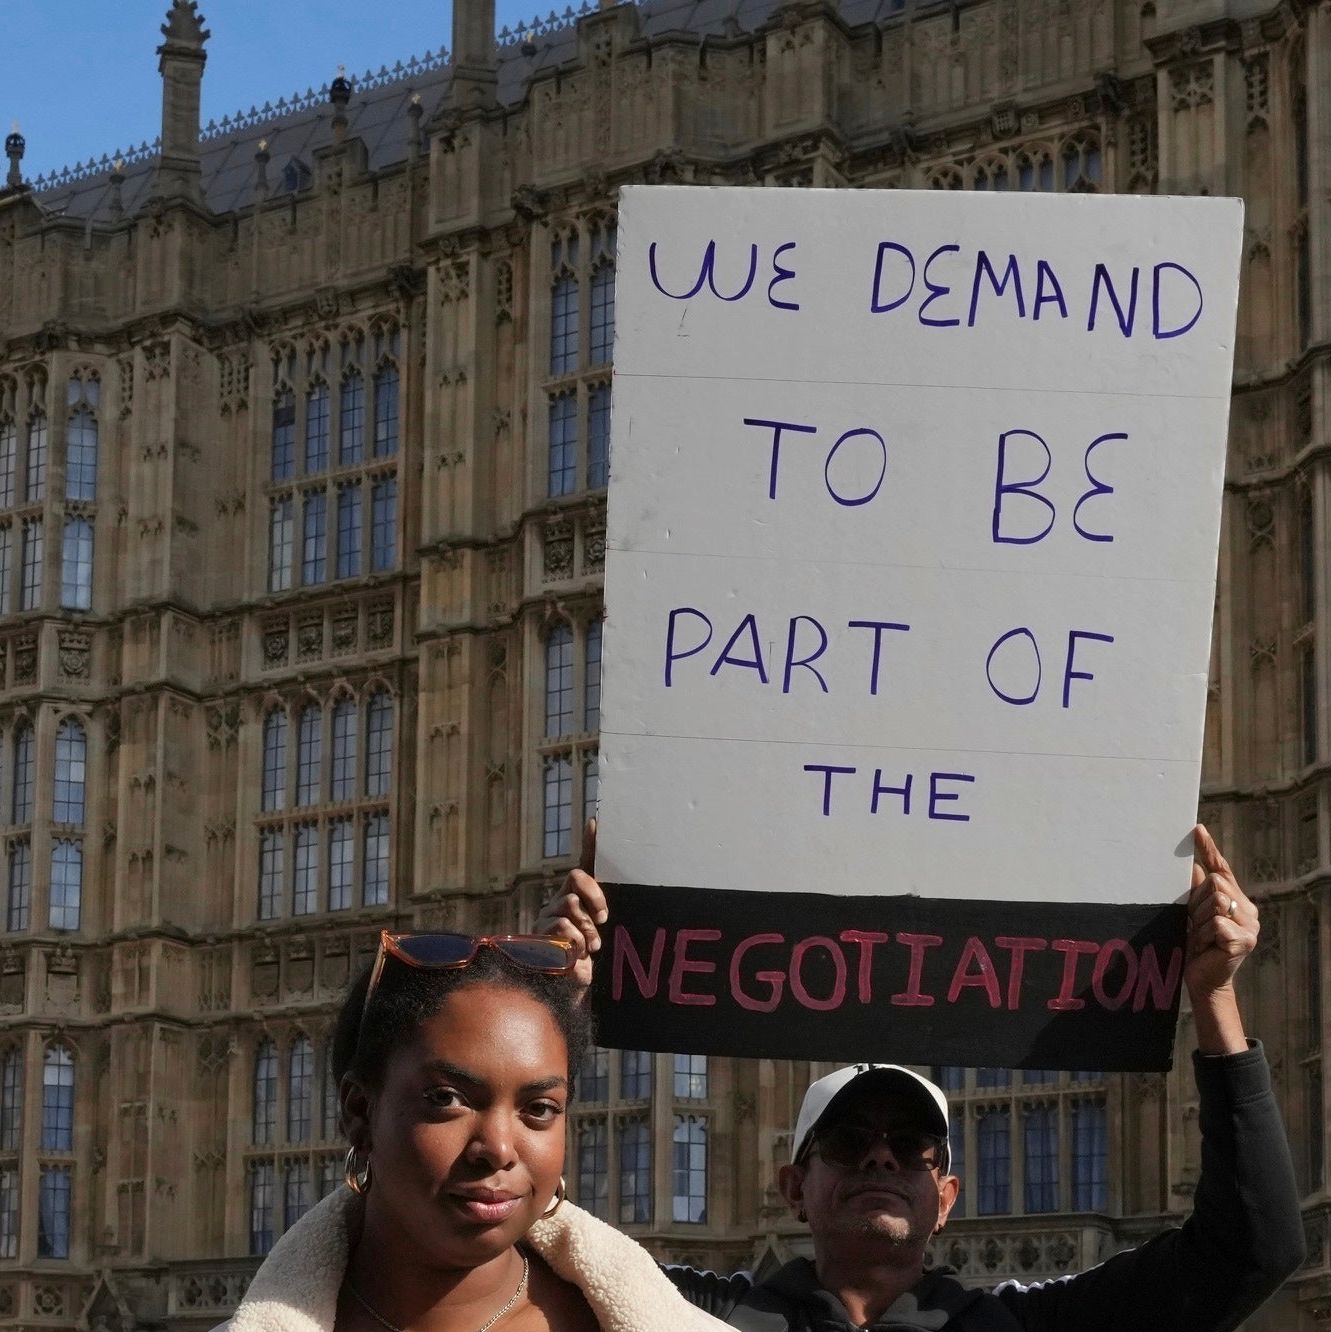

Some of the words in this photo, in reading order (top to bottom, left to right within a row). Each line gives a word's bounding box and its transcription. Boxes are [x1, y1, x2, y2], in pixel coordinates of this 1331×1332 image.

[648, 241, 801, 311] WE
[870, 241, 1204, 340] DEMAND
[743, 418, 888, 507] TO
[991, 428, 1130, 545] BE
[664, 607, 911, 696] PART
[985, 627, 1116, 708] OF
[803, 764, 976, 822] THE
[612, 925, 1183, 1013] NEGOTIATION
